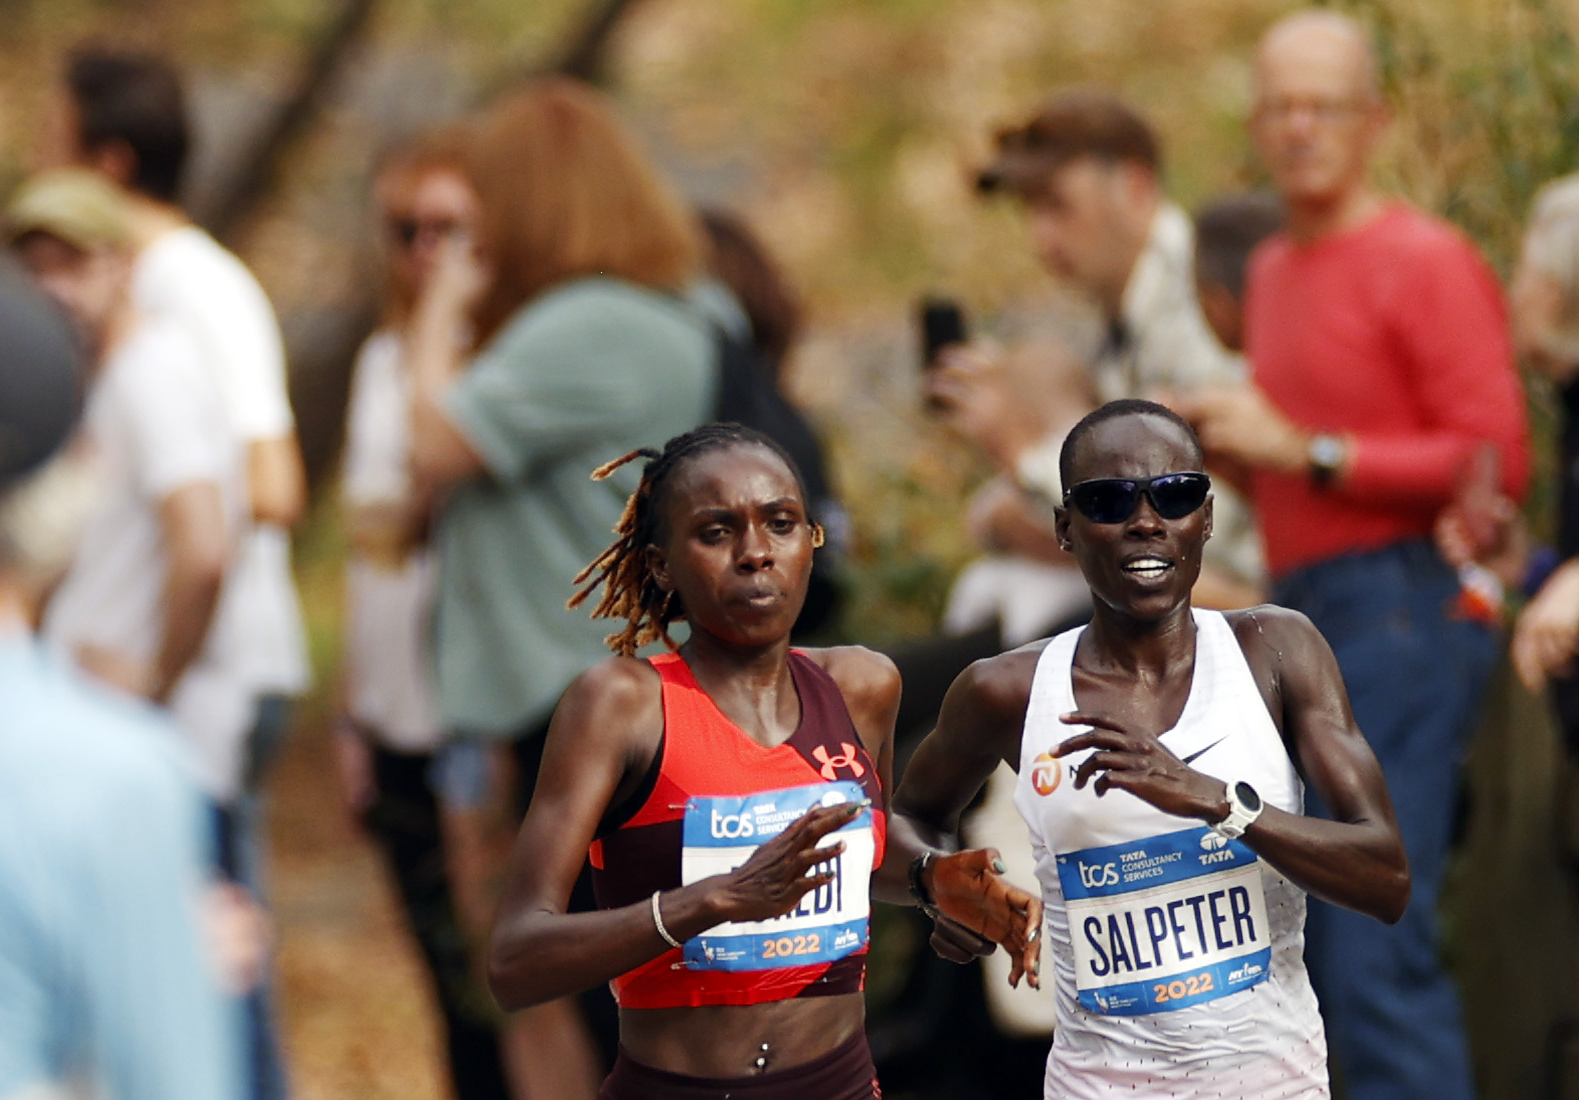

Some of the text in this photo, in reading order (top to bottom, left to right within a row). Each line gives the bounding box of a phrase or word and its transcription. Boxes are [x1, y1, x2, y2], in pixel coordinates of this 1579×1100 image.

[711, 809, 755, 838] tcs
[1120, 850, 1147, 863] TATA
[1121, 852, 1182, 873] CONSULTANCY
[1199, 850, 1235, 866] TATA
[1079, 861, 1120, 888] tcs
[1124, 867, 1164, 883] SERVICES
[1083, 885, 1257, 977] SALPETER
[762, 933, 821, 959] 2022
[1153, 972, 1215, 1003] 2022
